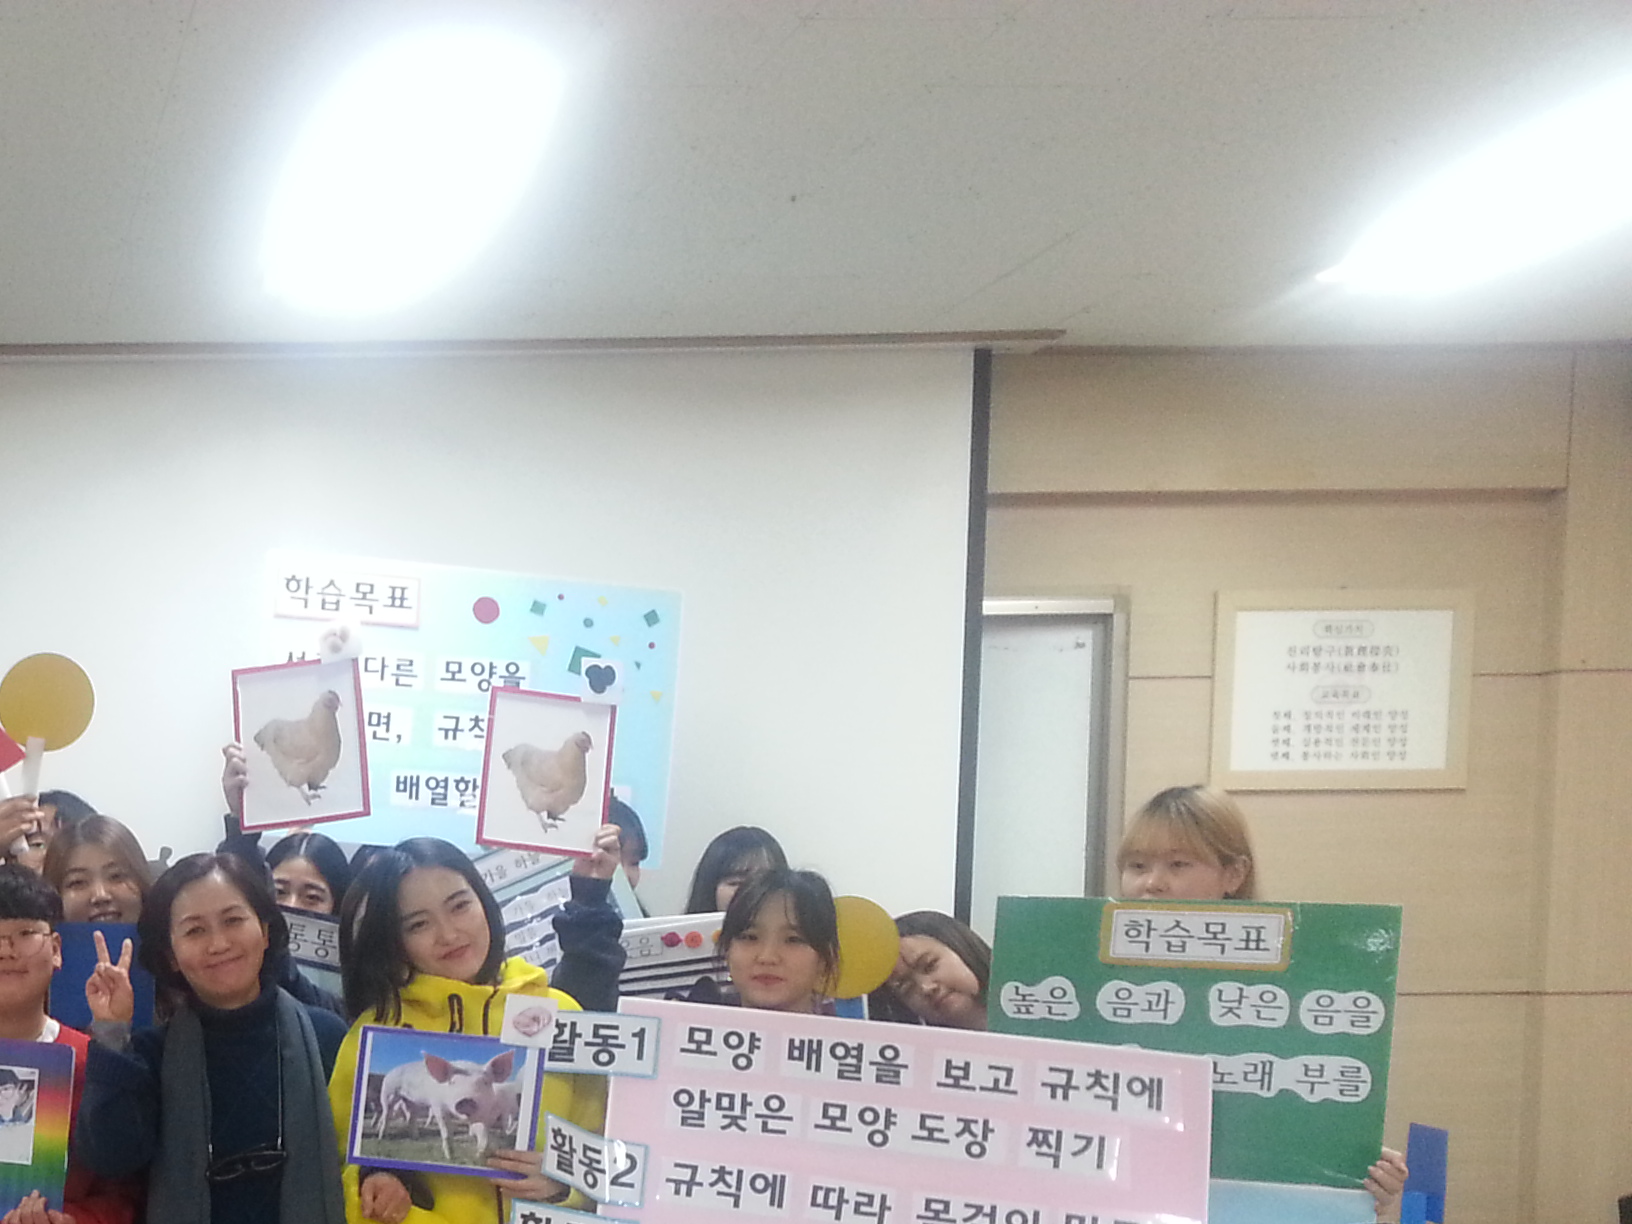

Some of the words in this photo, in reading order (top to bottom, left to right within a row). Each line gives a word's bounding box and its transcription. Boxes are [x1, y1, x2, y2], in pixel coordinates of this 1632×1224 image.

[284, 573, 413, 615] 학습목표
[363, 656, 418, 688] 다른
[439, 660, 526, 693] 모양을
[1122, 917, 1270, 956] 학습목표
[1006, 983, 1074, 1017] 높은
[1105, 987, 1176, 1021] 음과
[1216, 986, 1285, 1022] 낮은
[1306, 992, 1379, 1029] 음을
[547, 1017, 647, 1067] 활동1
[679, 1025, 762, 1072] 모양
[787, 1035, 909, 1087] 배열을
[936, 1057, 1019, 1097] 보고
[1040, 1065, 1165, 1112] 규칙에
[1211, 1059, 1275, 1093] 노래
[1295, 1061, 1369, 1099] 부를
[672, 1087, 795, 1137] 알맞은
[813, 1100, 897, 1149] 모양
[910, 1112, 996, 1160] 도장
[1025, 1125, 1108, 1171] 찍기
[549, 1126, 638, 1191] 활동2
[664, 1160, 787, 1210] 규칙에
